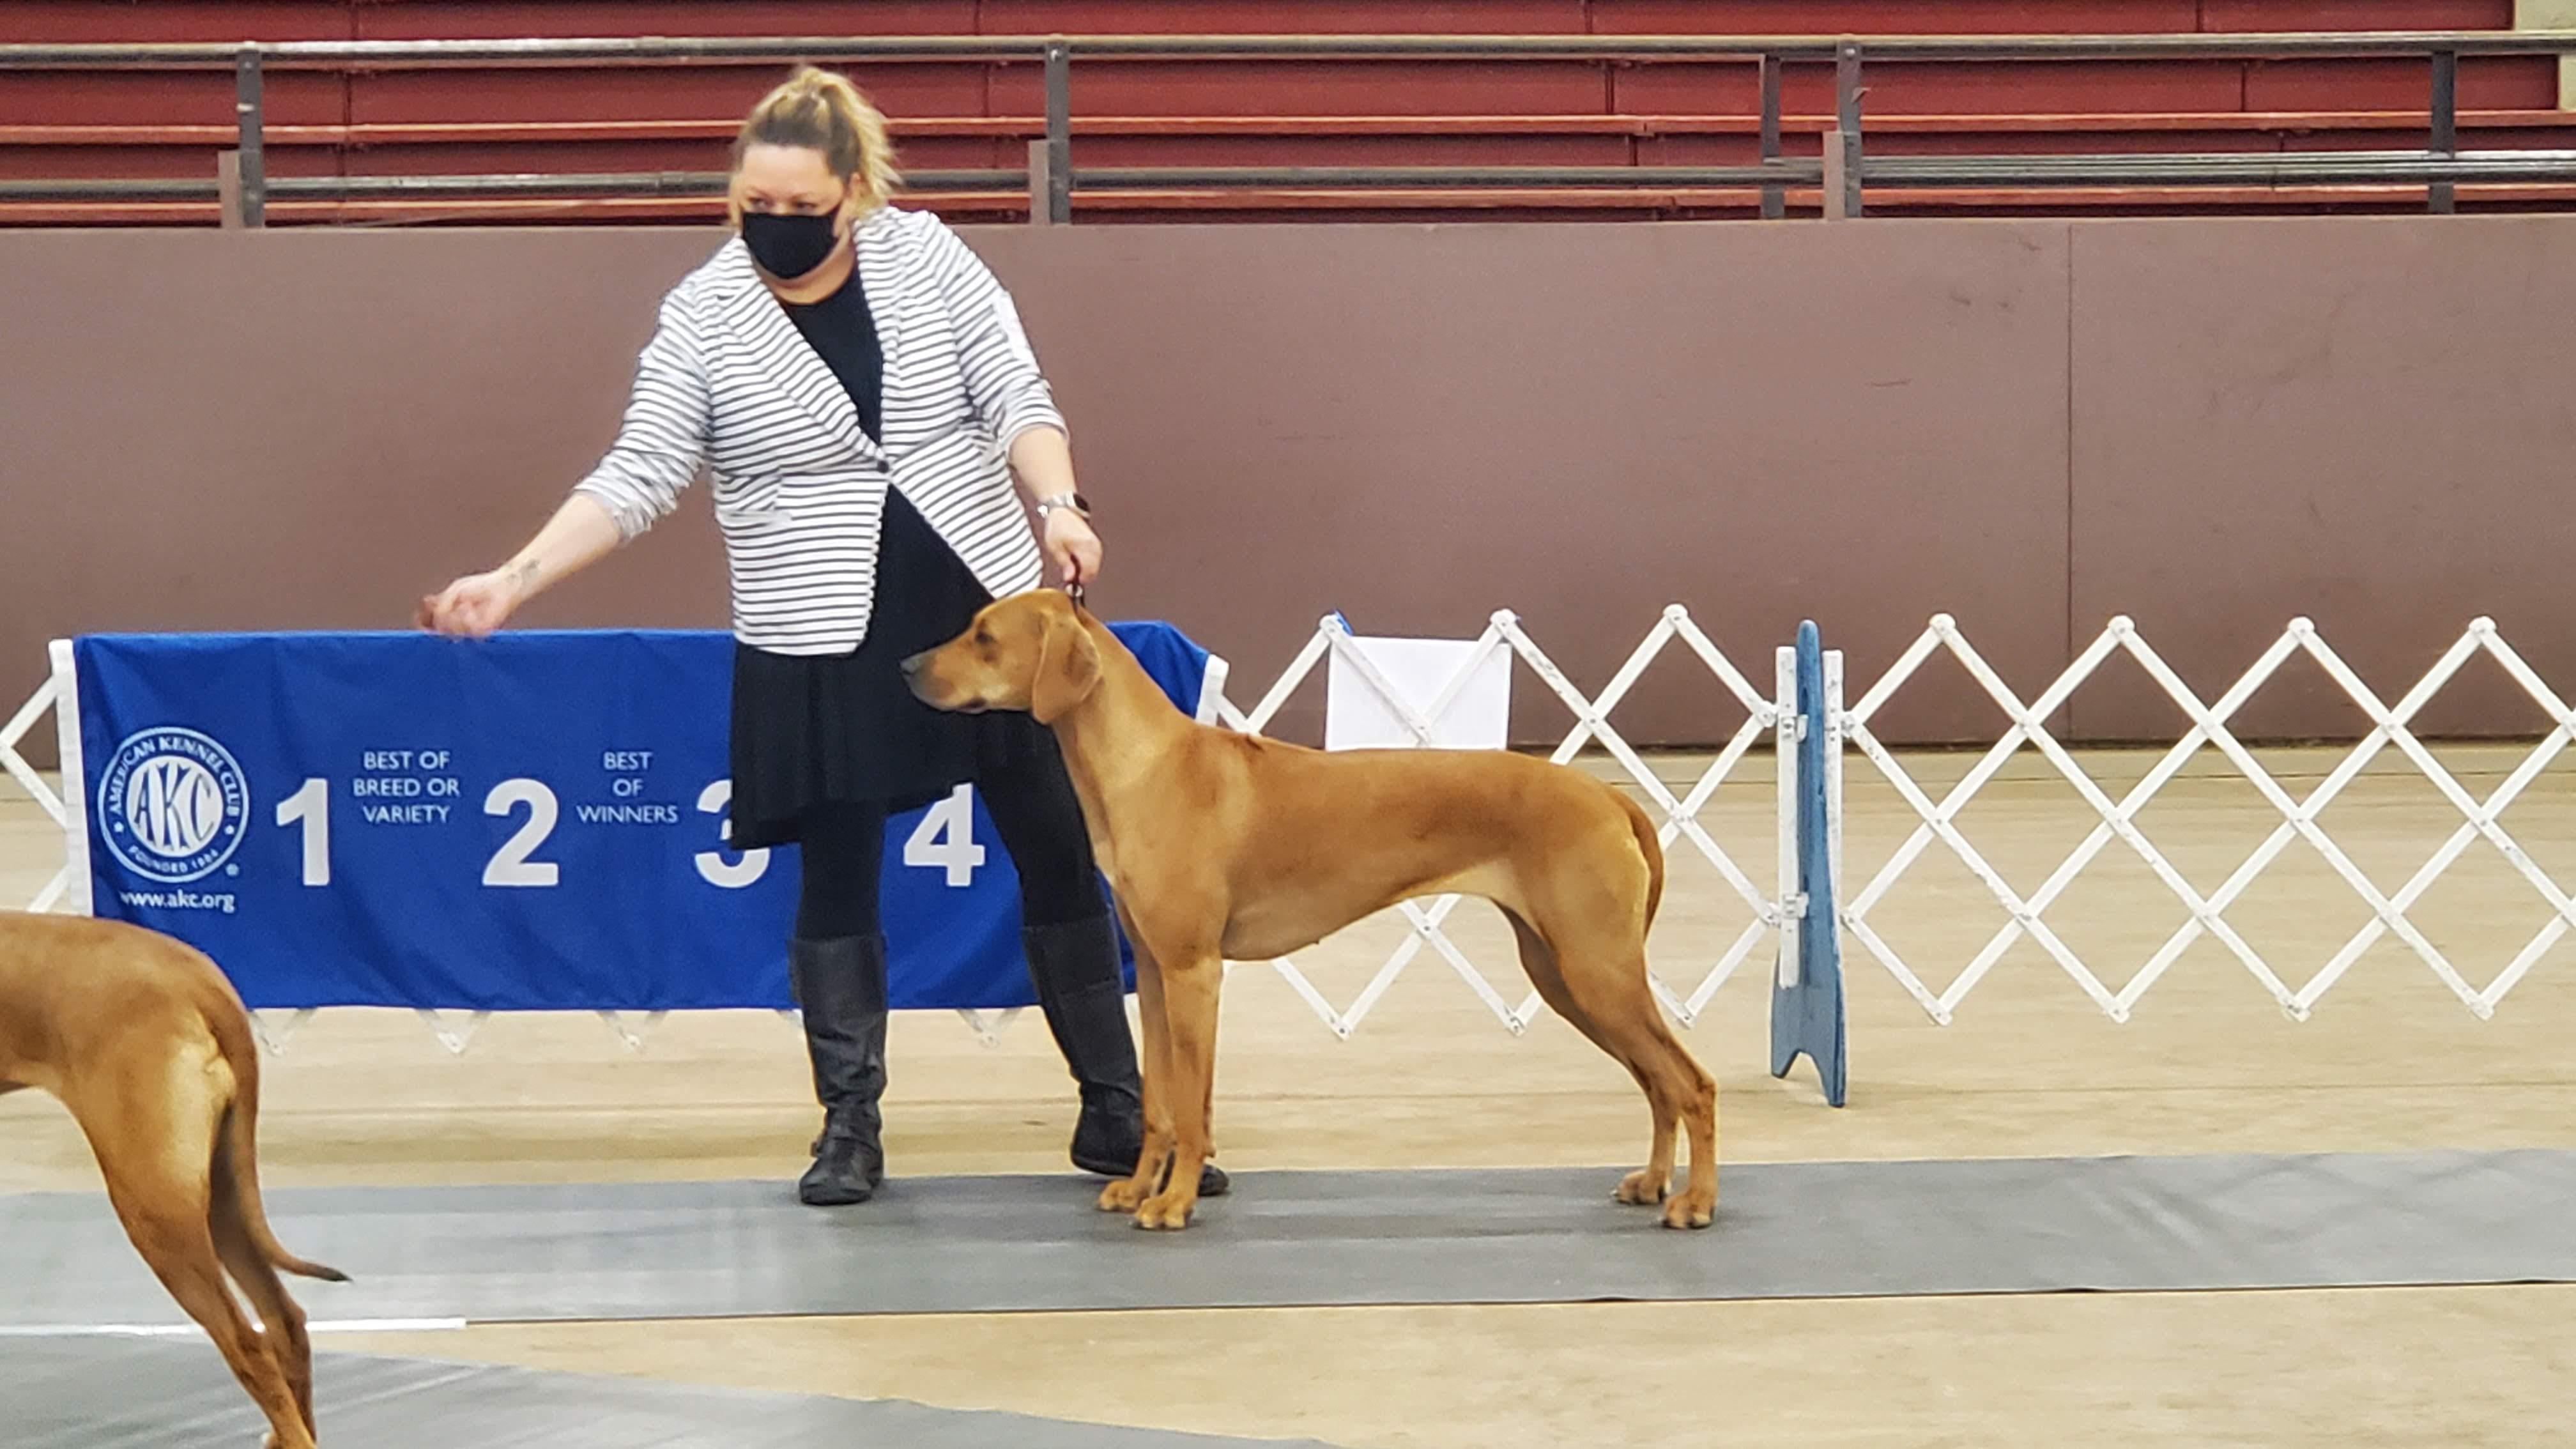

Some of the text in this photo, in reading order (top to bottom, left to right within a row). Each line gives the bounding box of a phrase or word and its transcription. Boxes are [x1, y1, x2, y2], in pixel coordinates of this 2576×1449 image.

[364, 751, 450, 769] BEST OF
[603, 752, 652, 769] BEST
[109, 736, 241, 818] AMERICAN KENNEL CLUB
[353, 778, 460, 797] BREED OR
[613, 779, 644, 796] OF
[134, 762, 215, 851] AKC
[362, 805, 450, 824] VARIETY
[576, 805, 679, 824] WINNERS
[275, 778, 330, 886] 1
[482, 778, 559, 886] 2
[695, 779, 770, 889] 3
[903, 781, 986, 887] 4
[120, 889, 235, 914] www.akc.org
